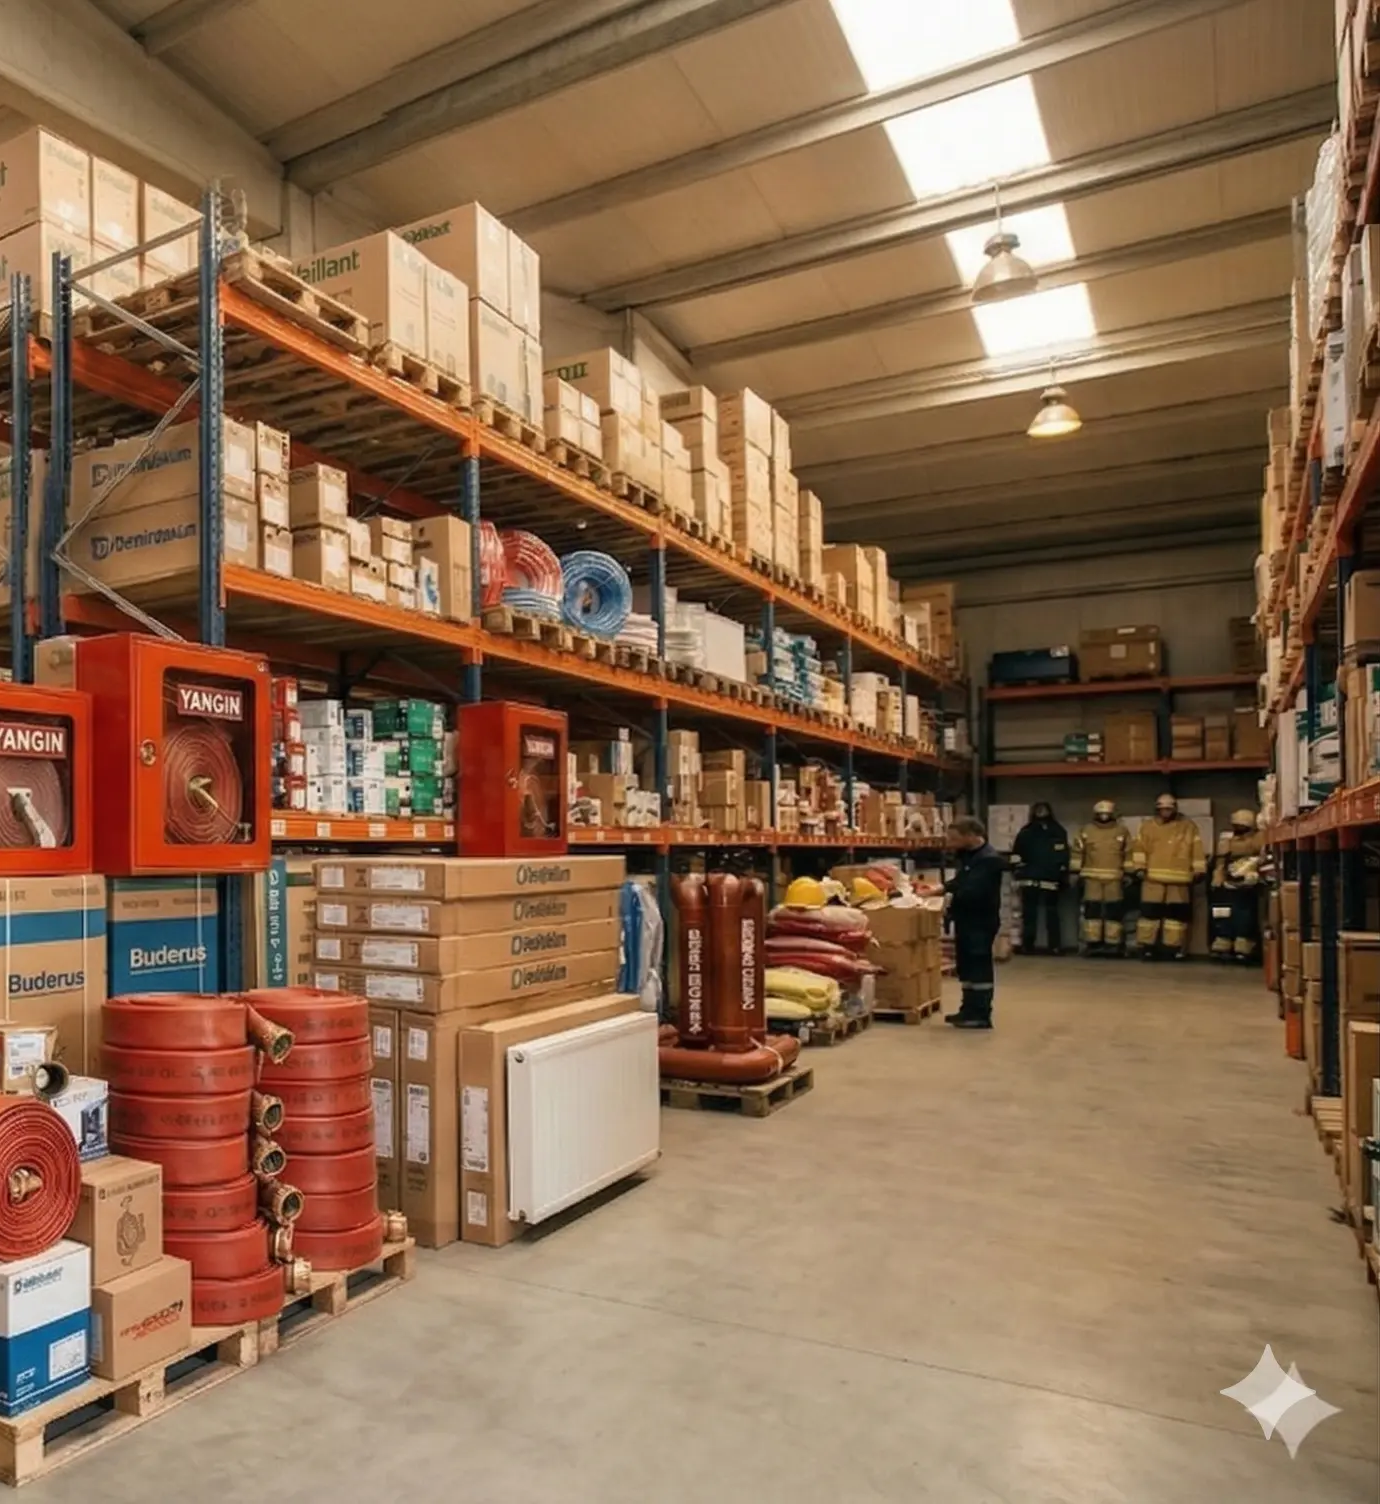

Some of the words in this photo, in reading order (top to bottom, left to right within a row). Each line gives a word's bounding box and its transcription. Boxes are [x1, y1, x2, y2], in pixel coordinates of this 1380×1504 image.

[180, 689, 241, 715] YANGIN
[130, 943, 207, 969] Buderus
[8, 969, 85, 994] Buderus
